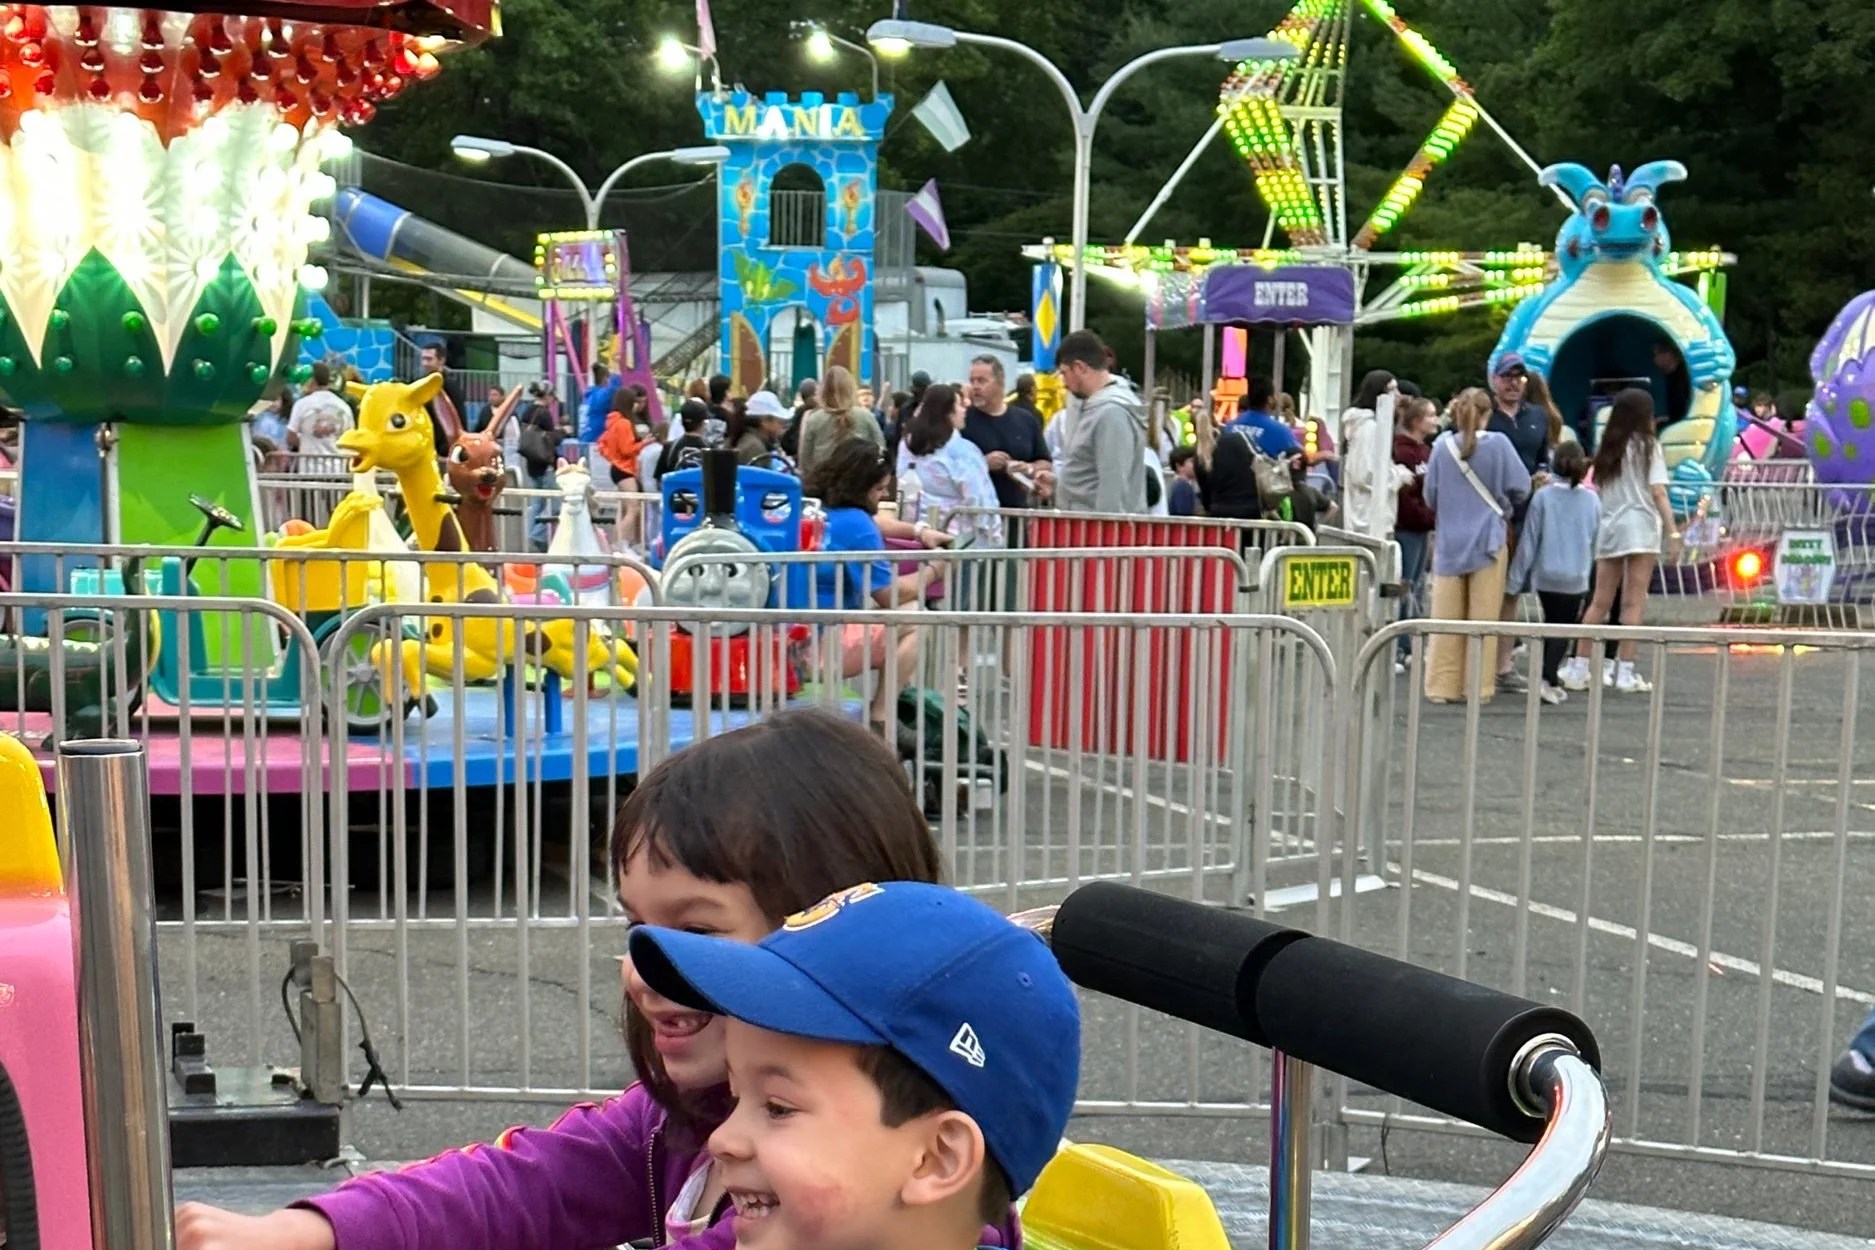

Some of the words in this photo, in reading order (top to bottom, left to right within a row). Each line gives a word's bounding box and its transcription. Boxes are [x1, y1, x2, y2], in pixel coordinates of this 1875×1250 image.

[724, 104, 864, 139] MANIA
[1254, 281, 1309, 306] ENTER
[1289, 562, 1351, 601] ENTER
